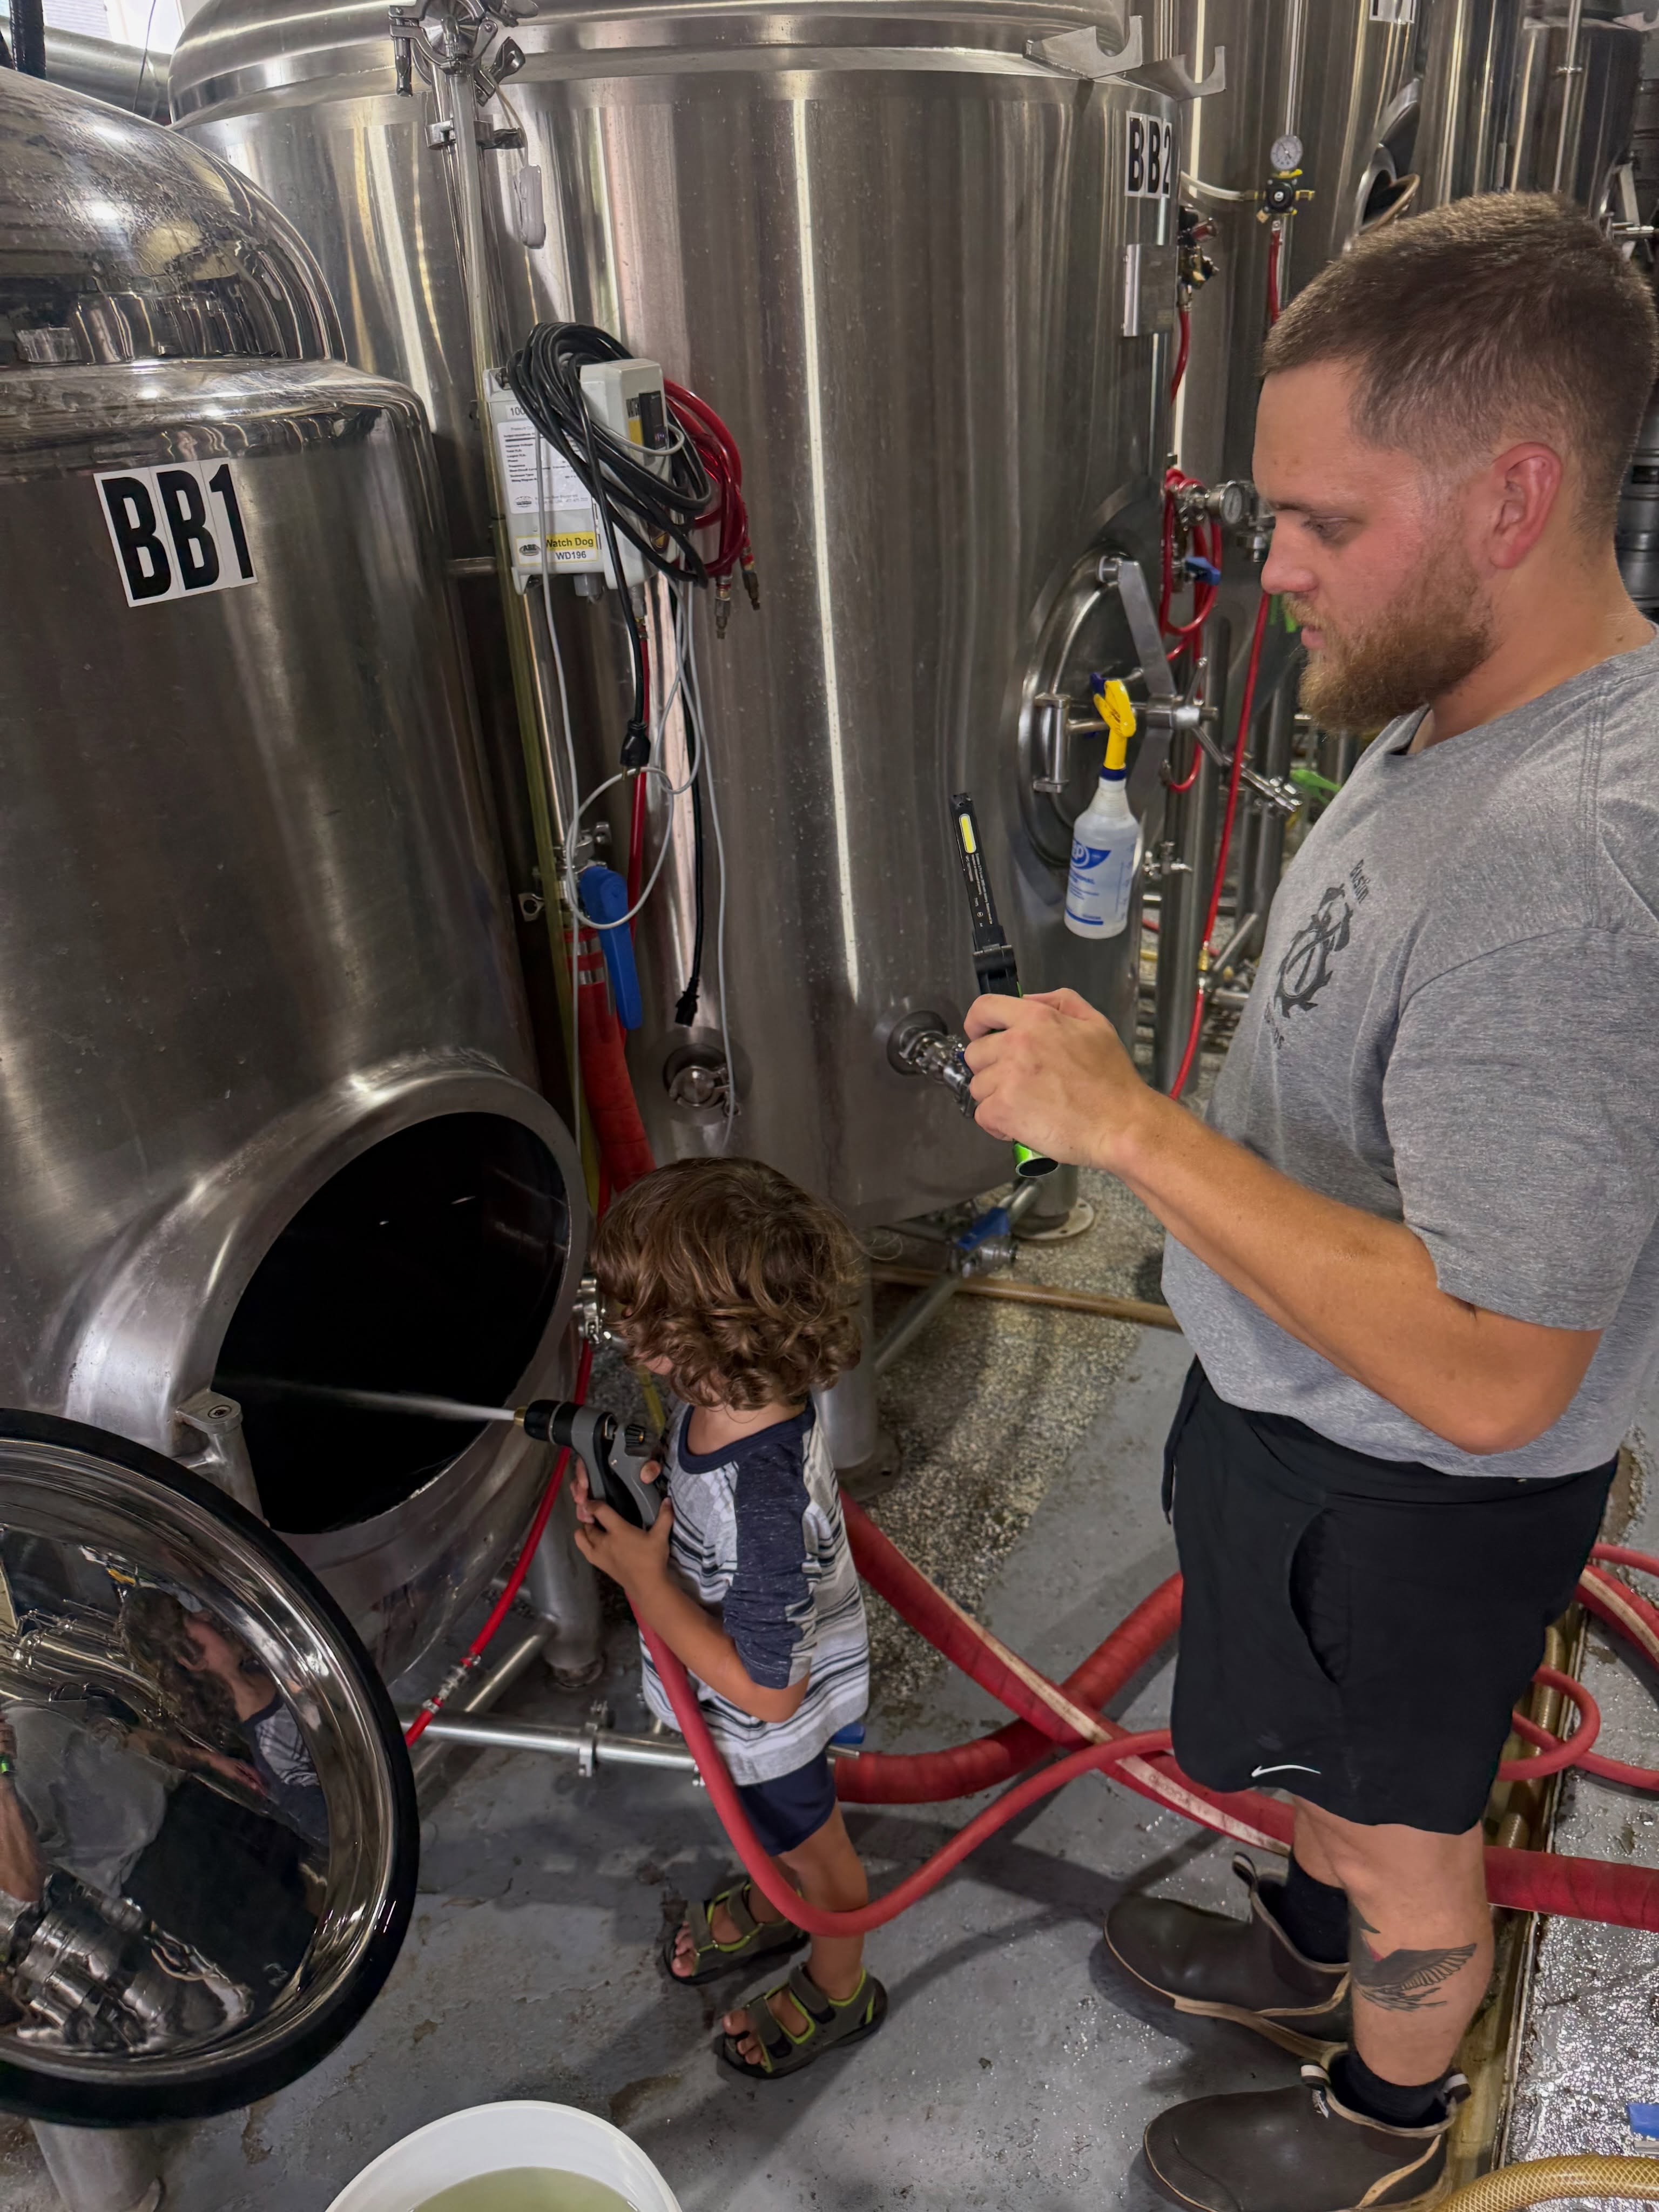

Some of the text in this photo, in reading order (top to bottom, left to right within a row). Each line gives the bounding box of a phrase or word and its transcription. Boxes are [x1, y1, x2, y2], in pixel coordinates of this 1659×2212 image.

[1128, 117, 1171, 194] BB2
[101, 463, 254, 601] BB1
[575, 537, 594, 547] Dog
[556, 551, 586, 560] WD196
